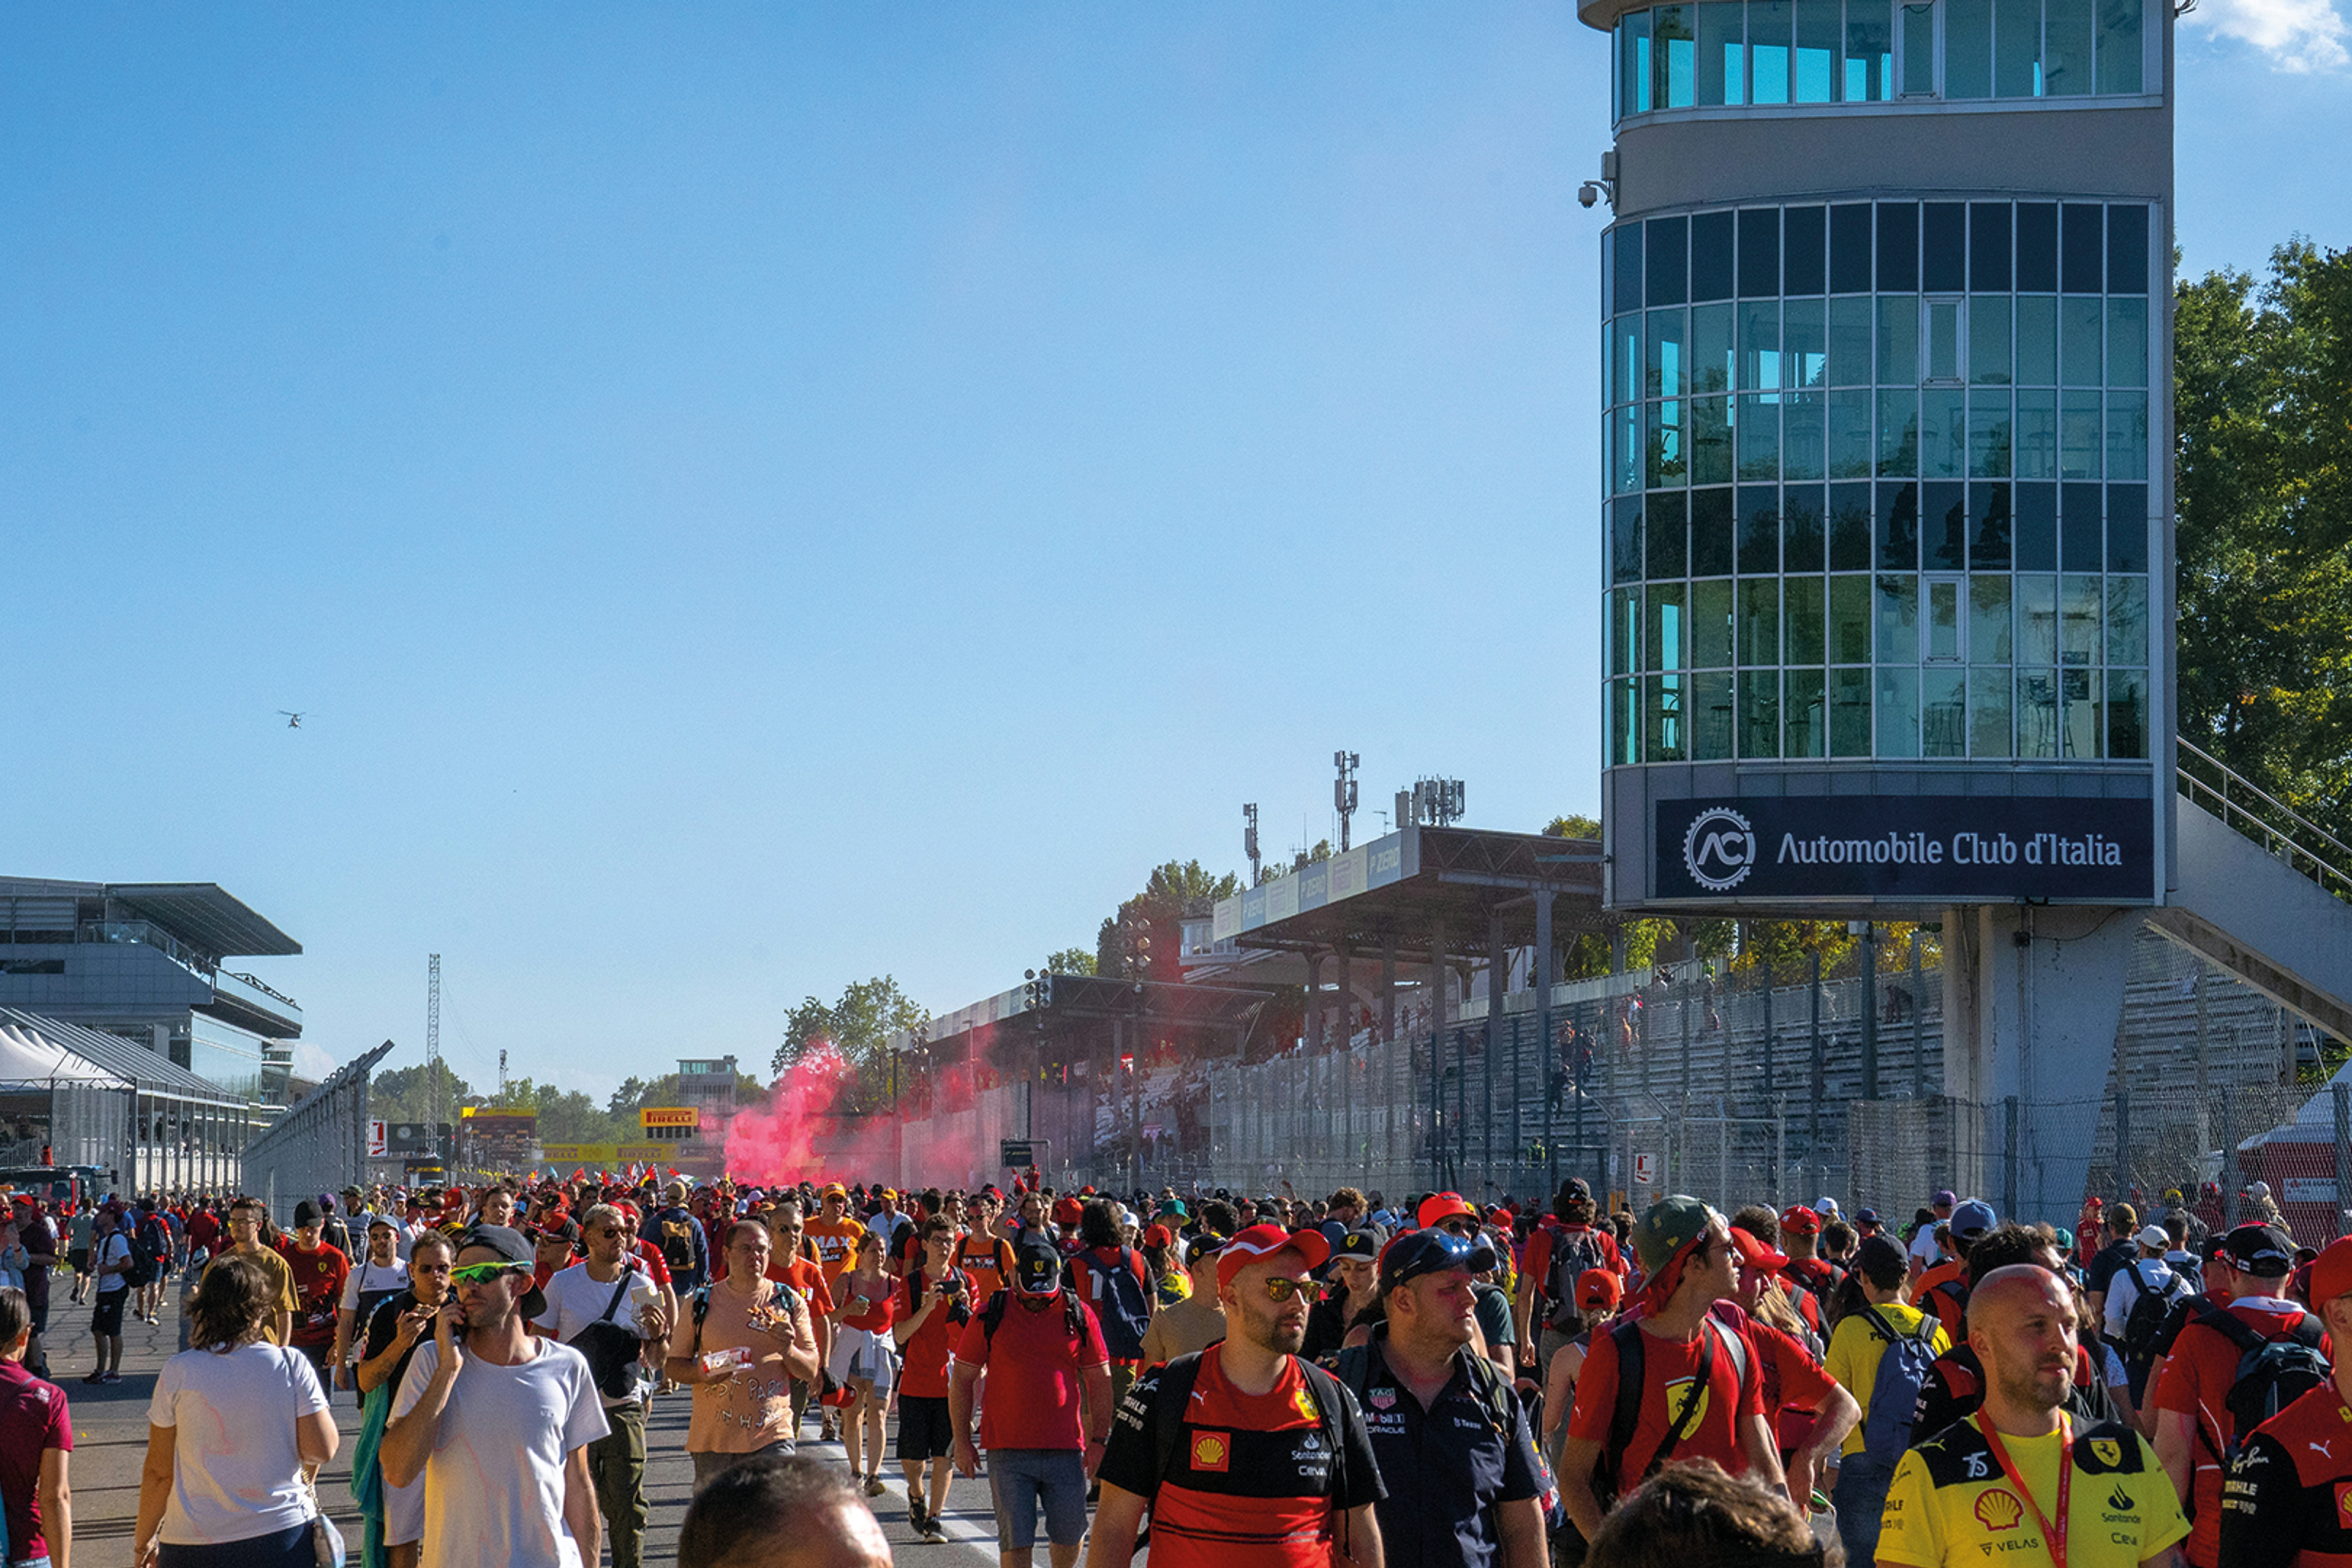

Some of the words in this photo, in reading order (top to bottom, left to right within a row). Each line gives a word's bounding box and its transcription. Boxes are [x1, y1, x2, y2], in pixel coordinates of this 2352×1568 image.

[1777, 832, 1943, 864] Automobile
[1953, 832, 2017, 864] Club
[2024, 832, 2122, 865] d'Italia
[646, 1111, 692, 1123] PIRELLI
[2101, 1512, 2141, 1524] Santande
[1996, 1538, 2039, 1552] VELAS
